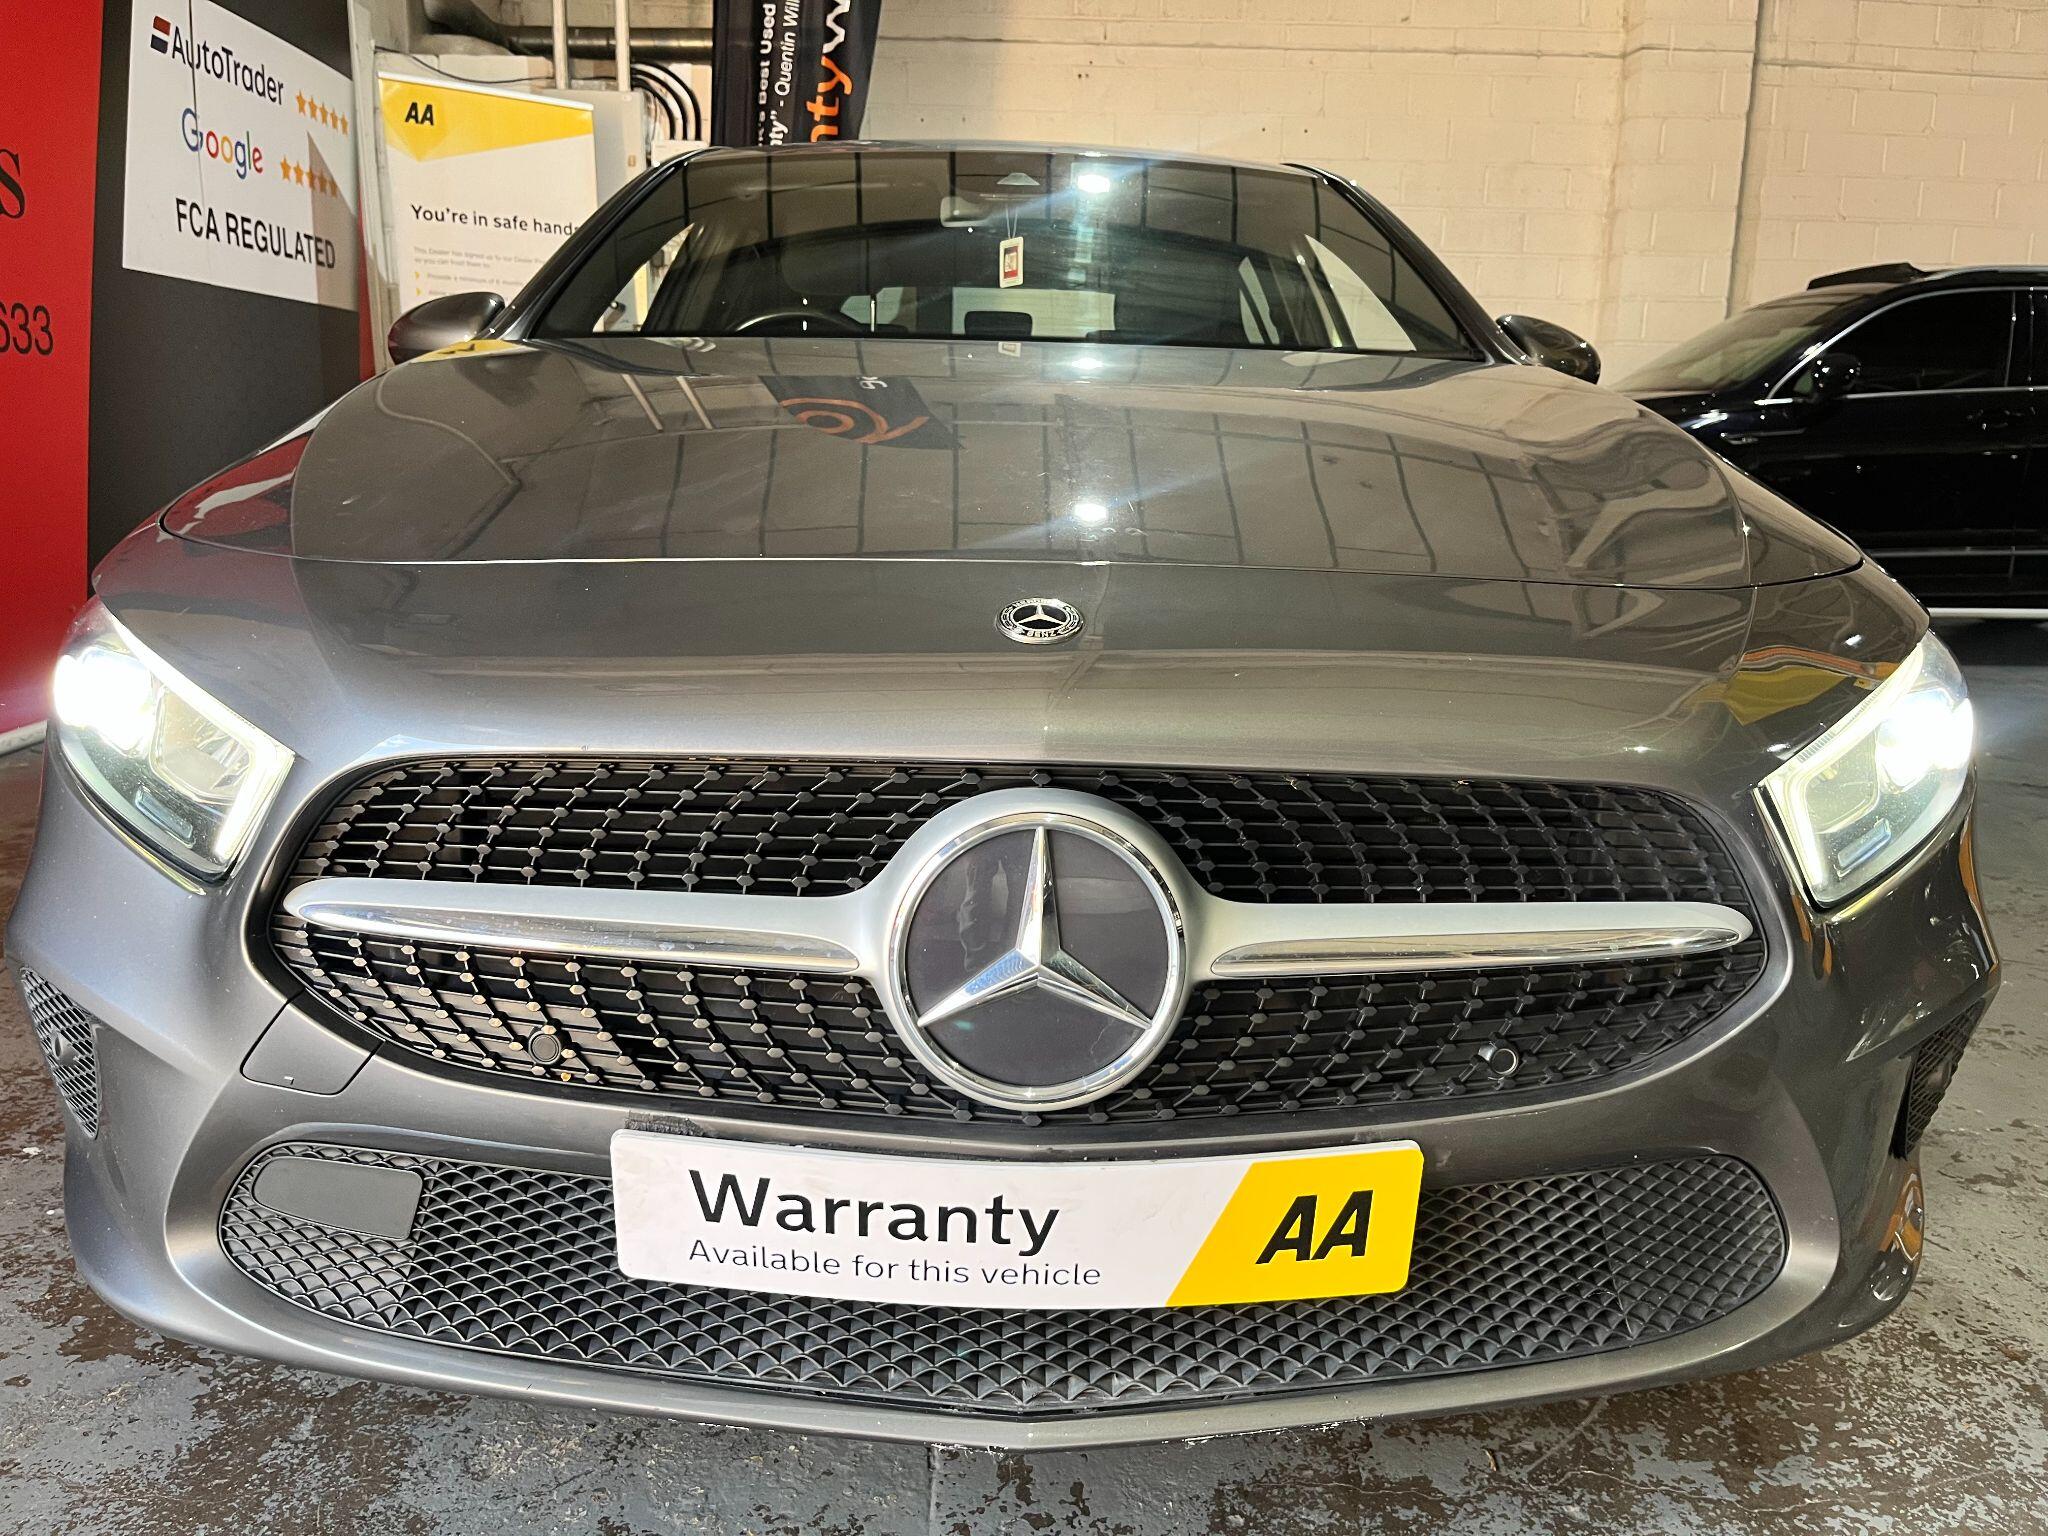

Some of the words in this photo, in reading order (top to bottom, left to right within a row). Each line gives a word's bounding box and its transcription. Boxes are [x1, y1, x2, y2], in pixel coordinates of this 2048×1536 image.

[760, 3, 776, 54] Used
[172, 26, 284, 105] AutoTrader
[758, 60, 770, 104] Best
[774, 31, 796, 96] Quentin
[182, 107, 263, 179] Google
[404, 102, 435, 126] AA
[175, 197, 220, 242] FCA
[225, 211, 336, 269] REGULATED
[473, 210, 488, 227] in
[493, 215, 528, 231] safe
[688, 1168, 1060, 1257] Warranty
[1256, 1189, 1375, 1266] AA
[688, 1239, 841, 1276] Available
[851, 1254, 900, 1279] for
[909, 1258, 970, 1284] this
[980, 1259, 1102, 1287] vehicle
